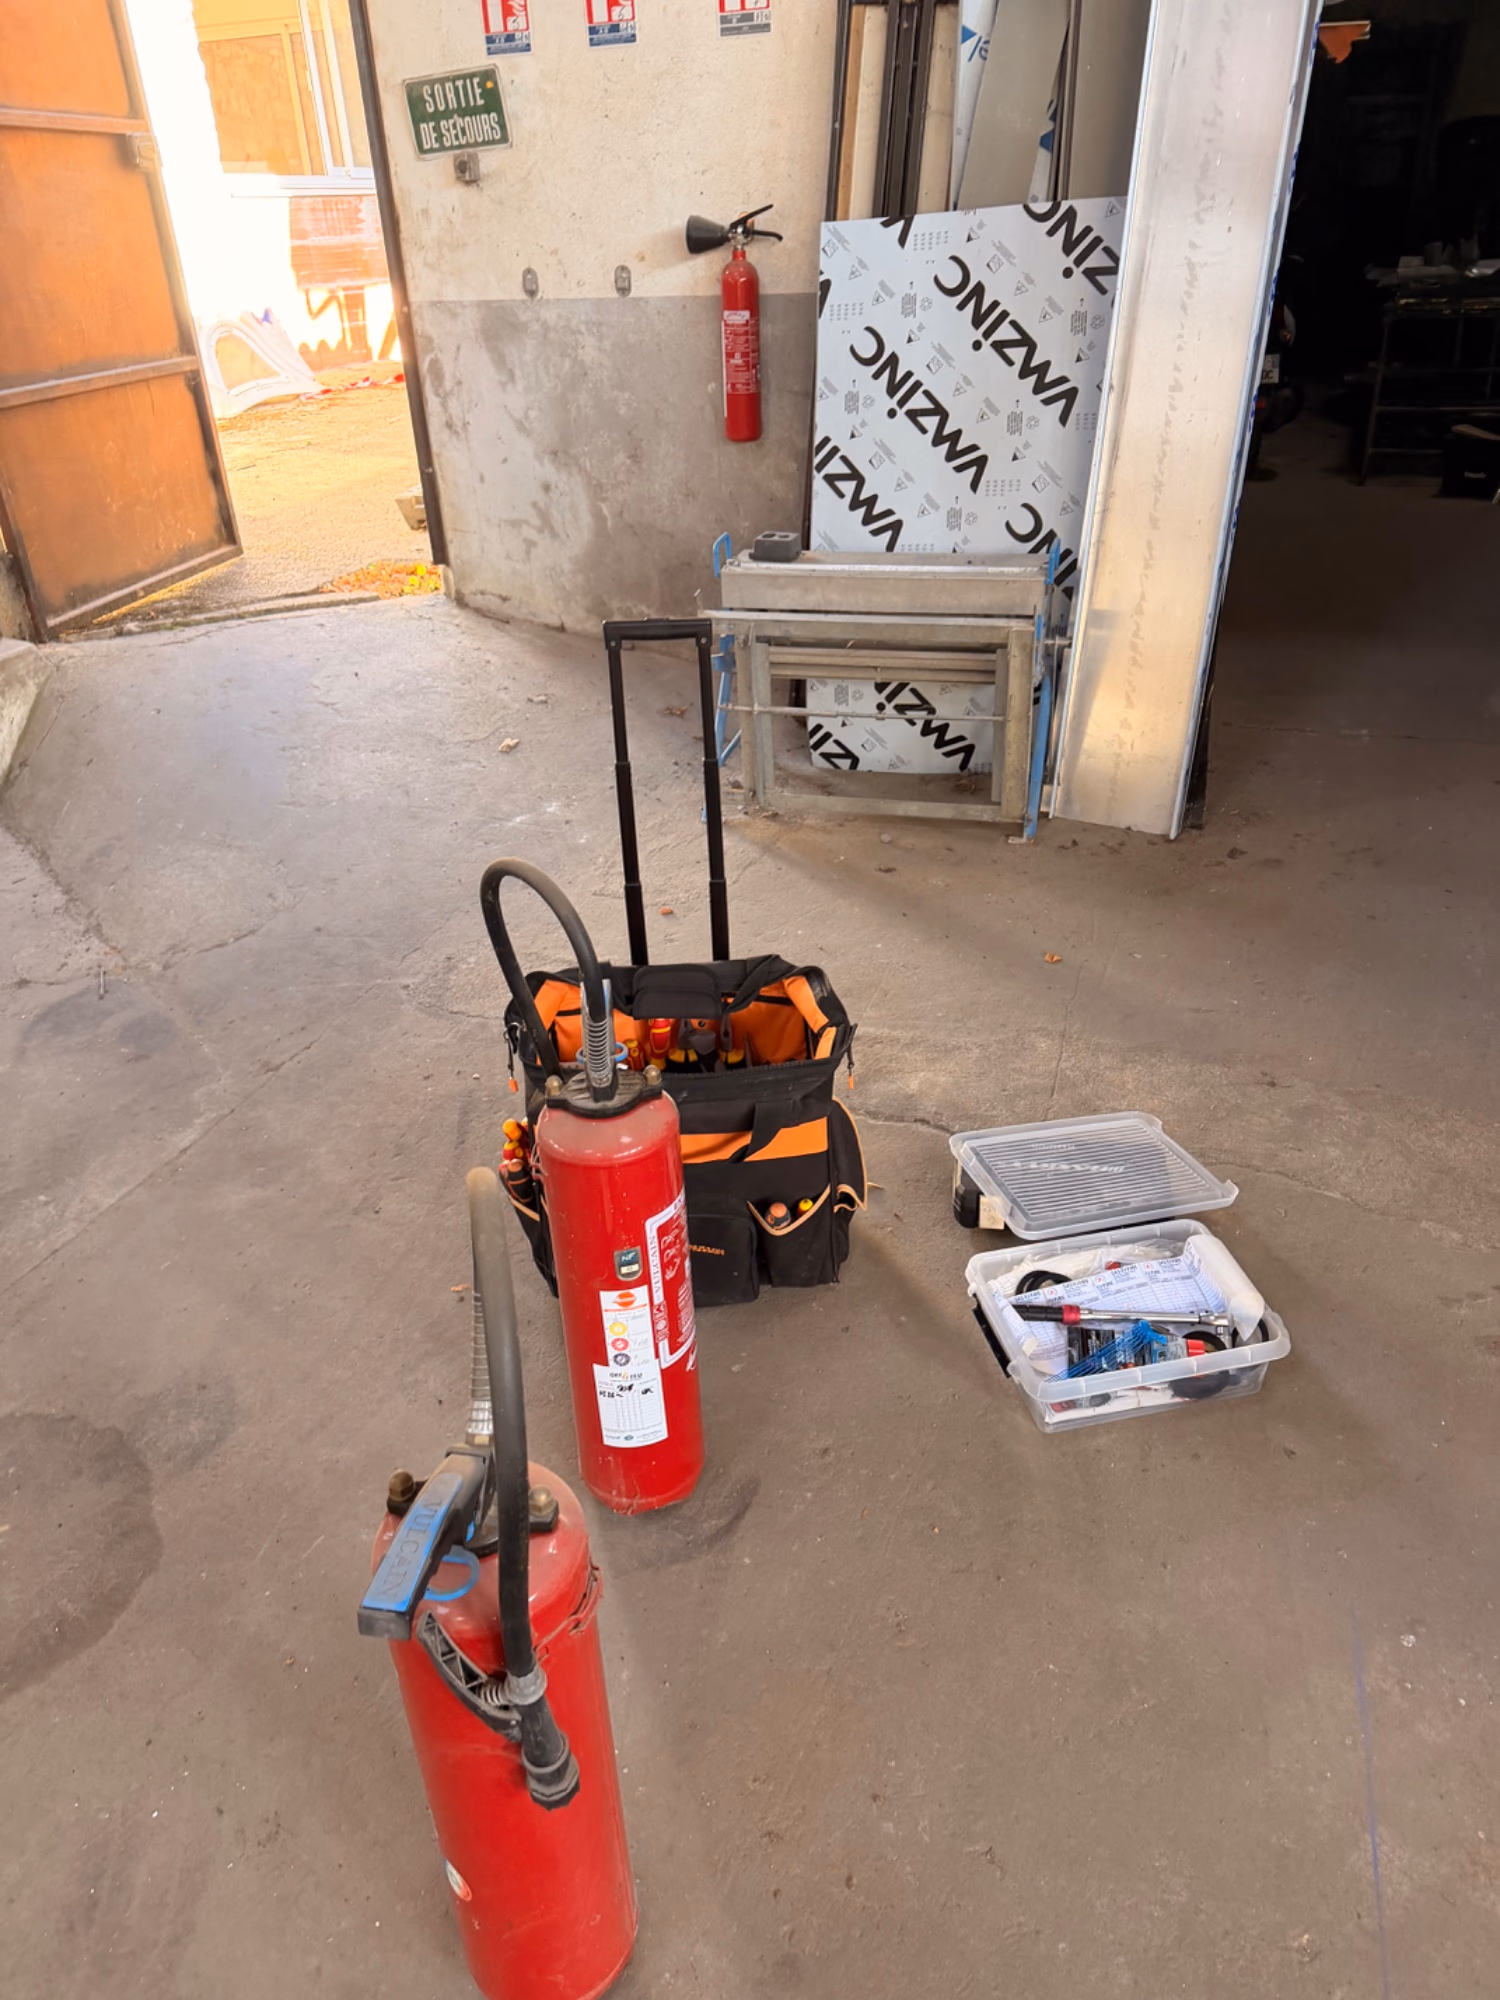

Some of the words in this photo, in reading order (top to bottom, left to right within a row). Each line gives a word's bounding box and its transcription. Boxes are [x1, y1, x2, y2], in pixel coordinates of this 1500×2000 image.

[422, 77, 485, 113] SORTIE
[419, 121, 440, 150] DE
[440, 112, 501, 148] SECOURS
